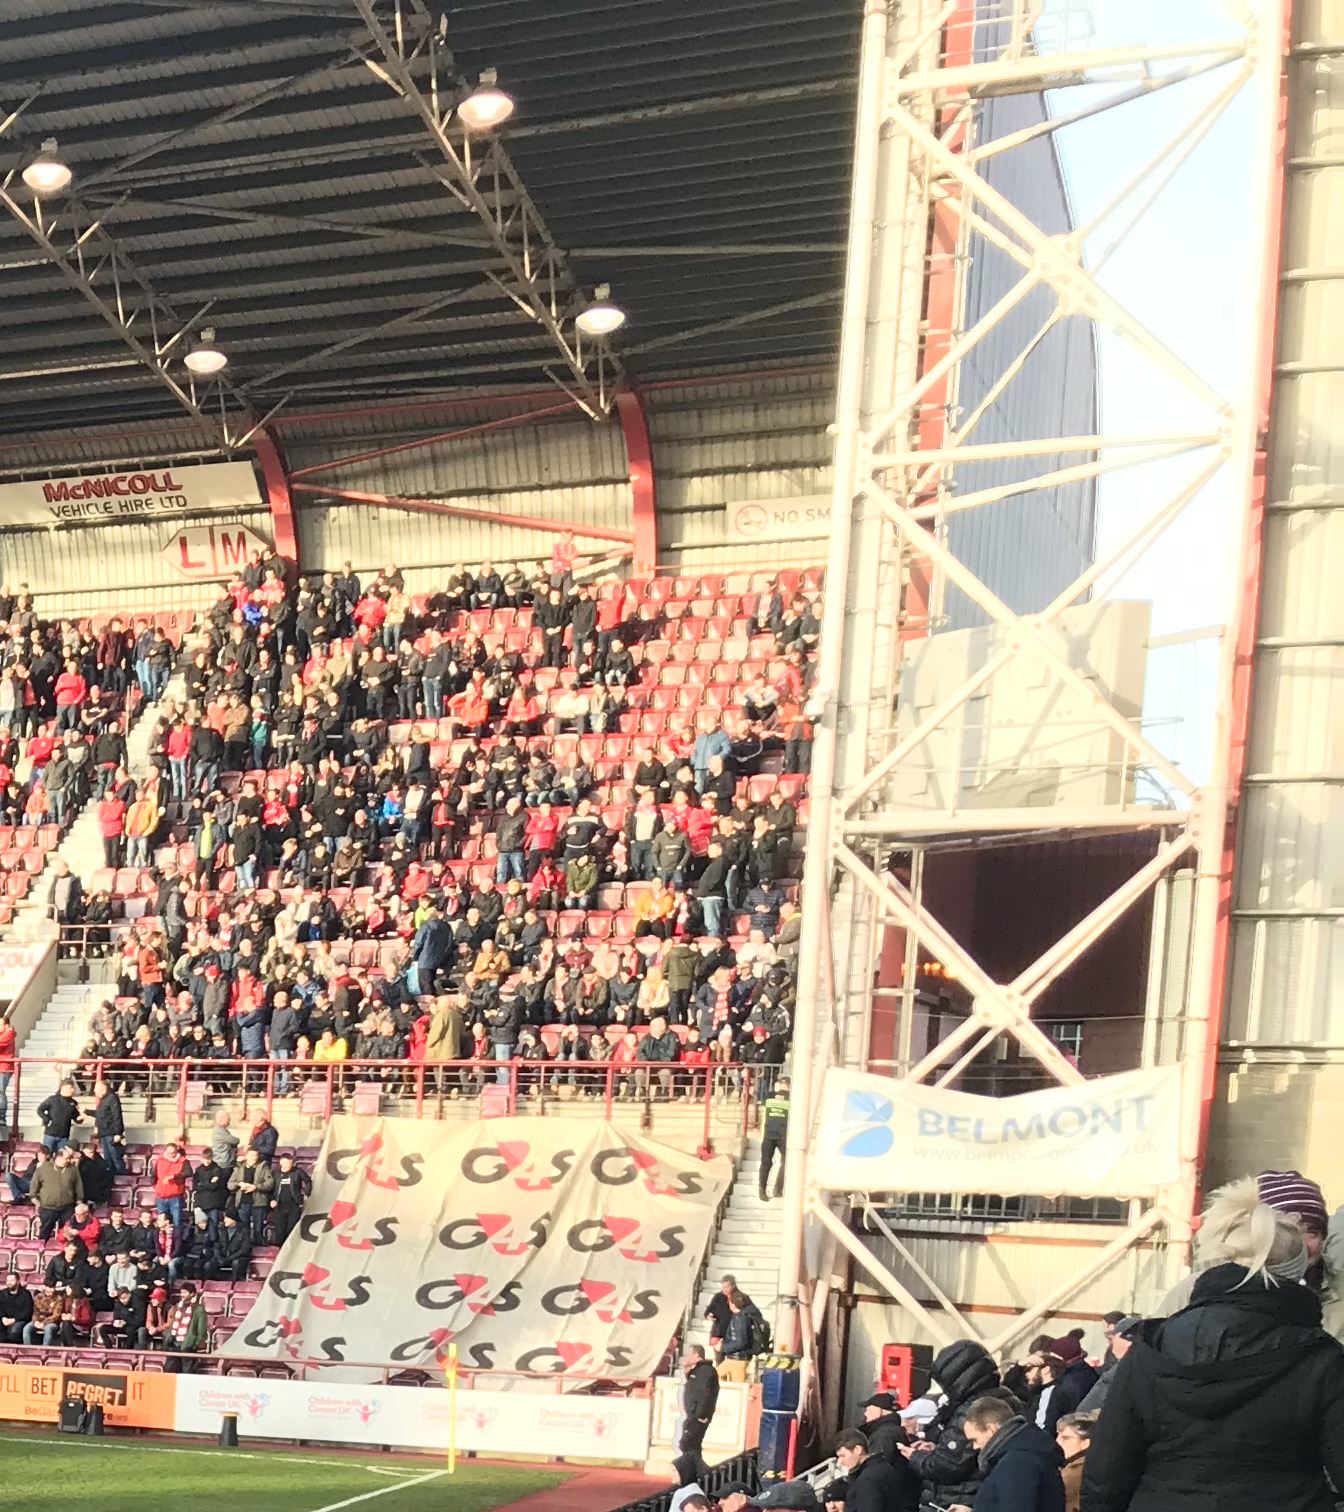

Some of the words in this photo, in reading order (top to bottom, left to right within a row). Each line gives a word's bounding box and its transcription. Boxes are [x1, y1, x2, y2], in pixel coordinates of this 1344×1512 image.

[49, 500, 113, 518] VEHICLE
[117, 497, 155, 515] HIRE
[160, 495, 188, 510] LTD
[179, 536, 206, 569] L
[221, 530, 249, 565] M
[917, 1094, 1155, 1145] BELMONT
[31, 1377, 57, 1395] BET
[67, 1380, 123, 1406] REGRET
[132, 1381, 146, 1400] IT
